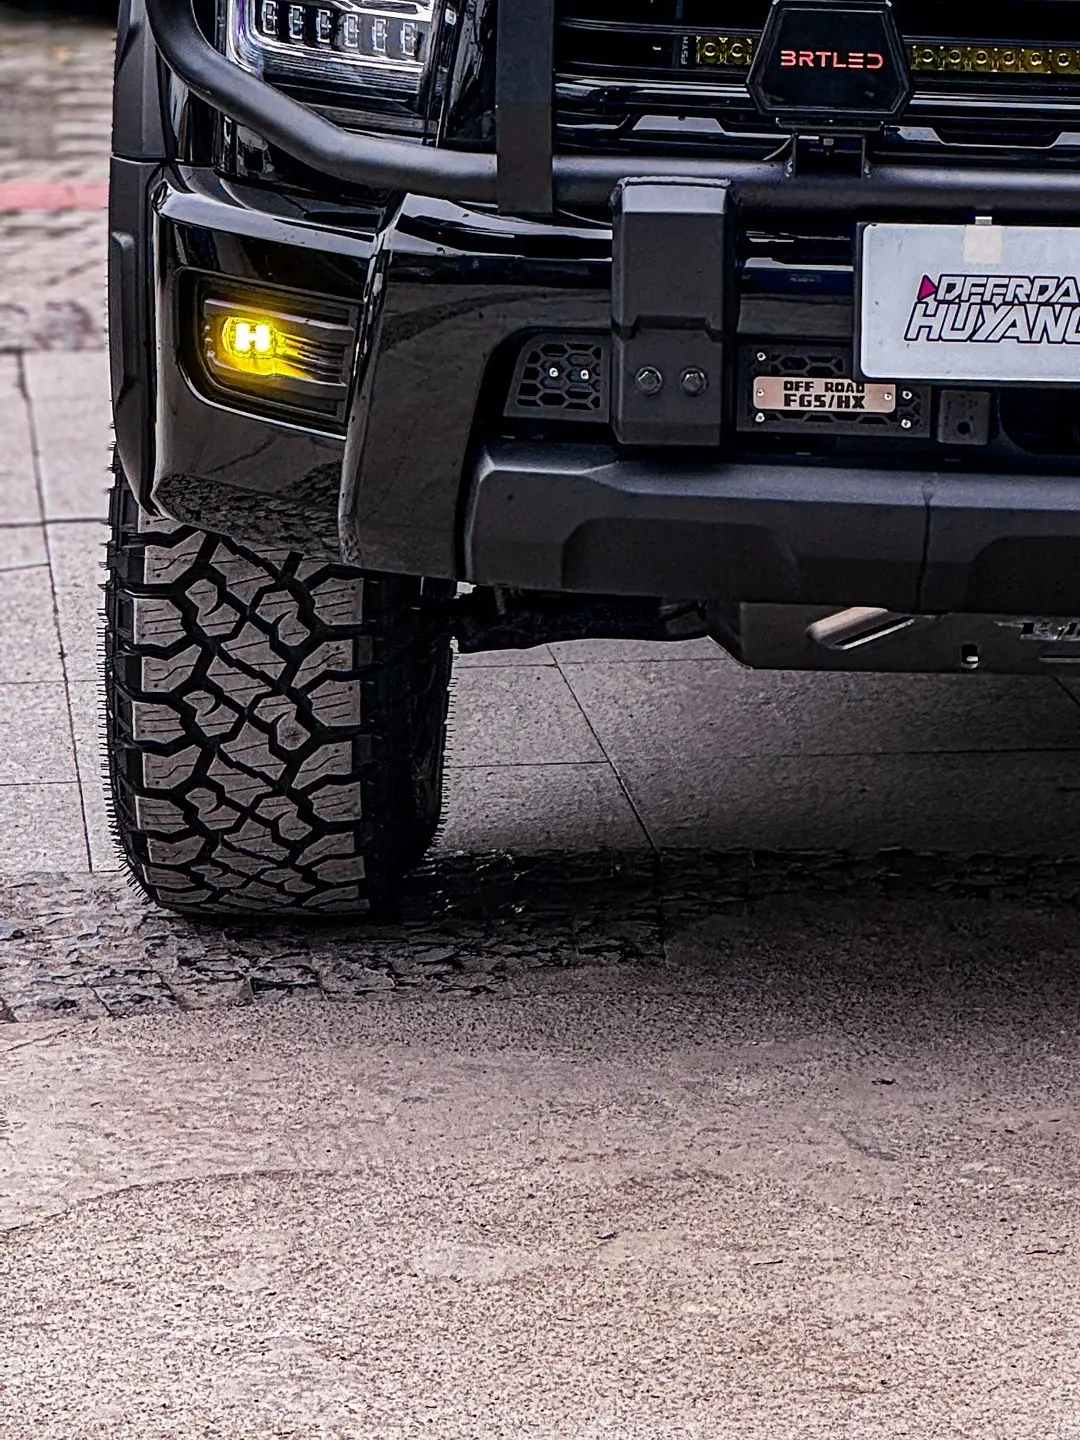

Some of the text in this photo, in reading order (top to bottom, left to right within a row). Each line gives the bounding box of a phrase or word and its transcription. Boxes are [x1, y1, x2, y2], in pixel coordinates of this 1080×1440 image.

[780, 50, 884, 69] BRTLED
[783, 380, 865, 394] OFF ROAD
